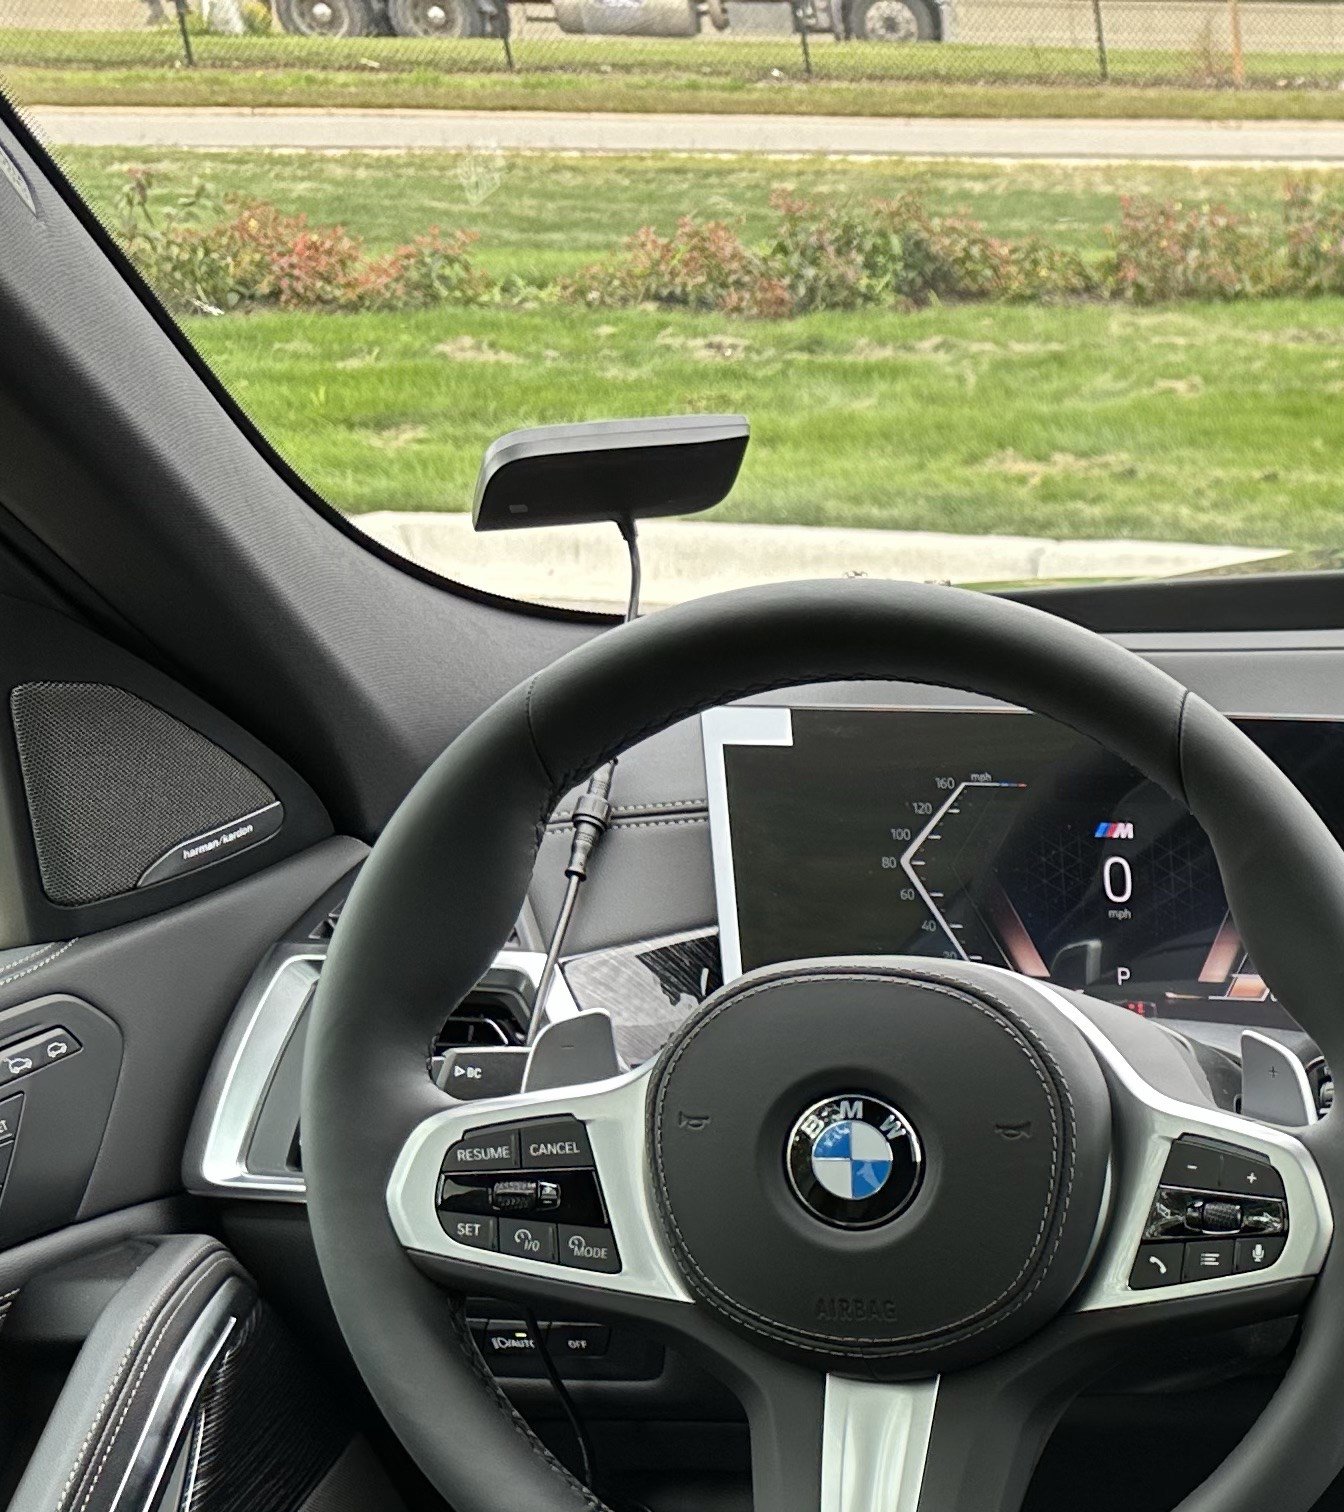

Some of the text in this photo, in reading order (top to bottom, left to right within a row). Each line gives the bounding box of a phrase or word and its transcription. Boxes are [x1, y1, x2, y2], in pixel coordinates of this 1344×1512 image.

[935, 778, 955, 789] 160
[971, 773, 992, 782] mph
[912, 803, 933, 814] 120
[891, 829, 911, 840] 100
[183, 825, 254, 860] harman/kardon
[882, 857, 897, 868] 80
[1103, 856, 1133, 903] 0
[900, 889, 915, 900] 60
[1108, 908, 1132, 919] mph
[921, 920, 936, 931] 40
[1117, 967, 1131, 985] P
[800, 1099, 908, 1142] BMW
[457, 1145, 511, 1162] RESUME
[529, 1141, 581, 1157] CANCEL
[457, 1222, 480, 1237] SET
[573, 1246, 608, 1259] MODE
[814, 1298, 898, 1322] AIRBAG
[567, 1340, 587, 1349] OFF
